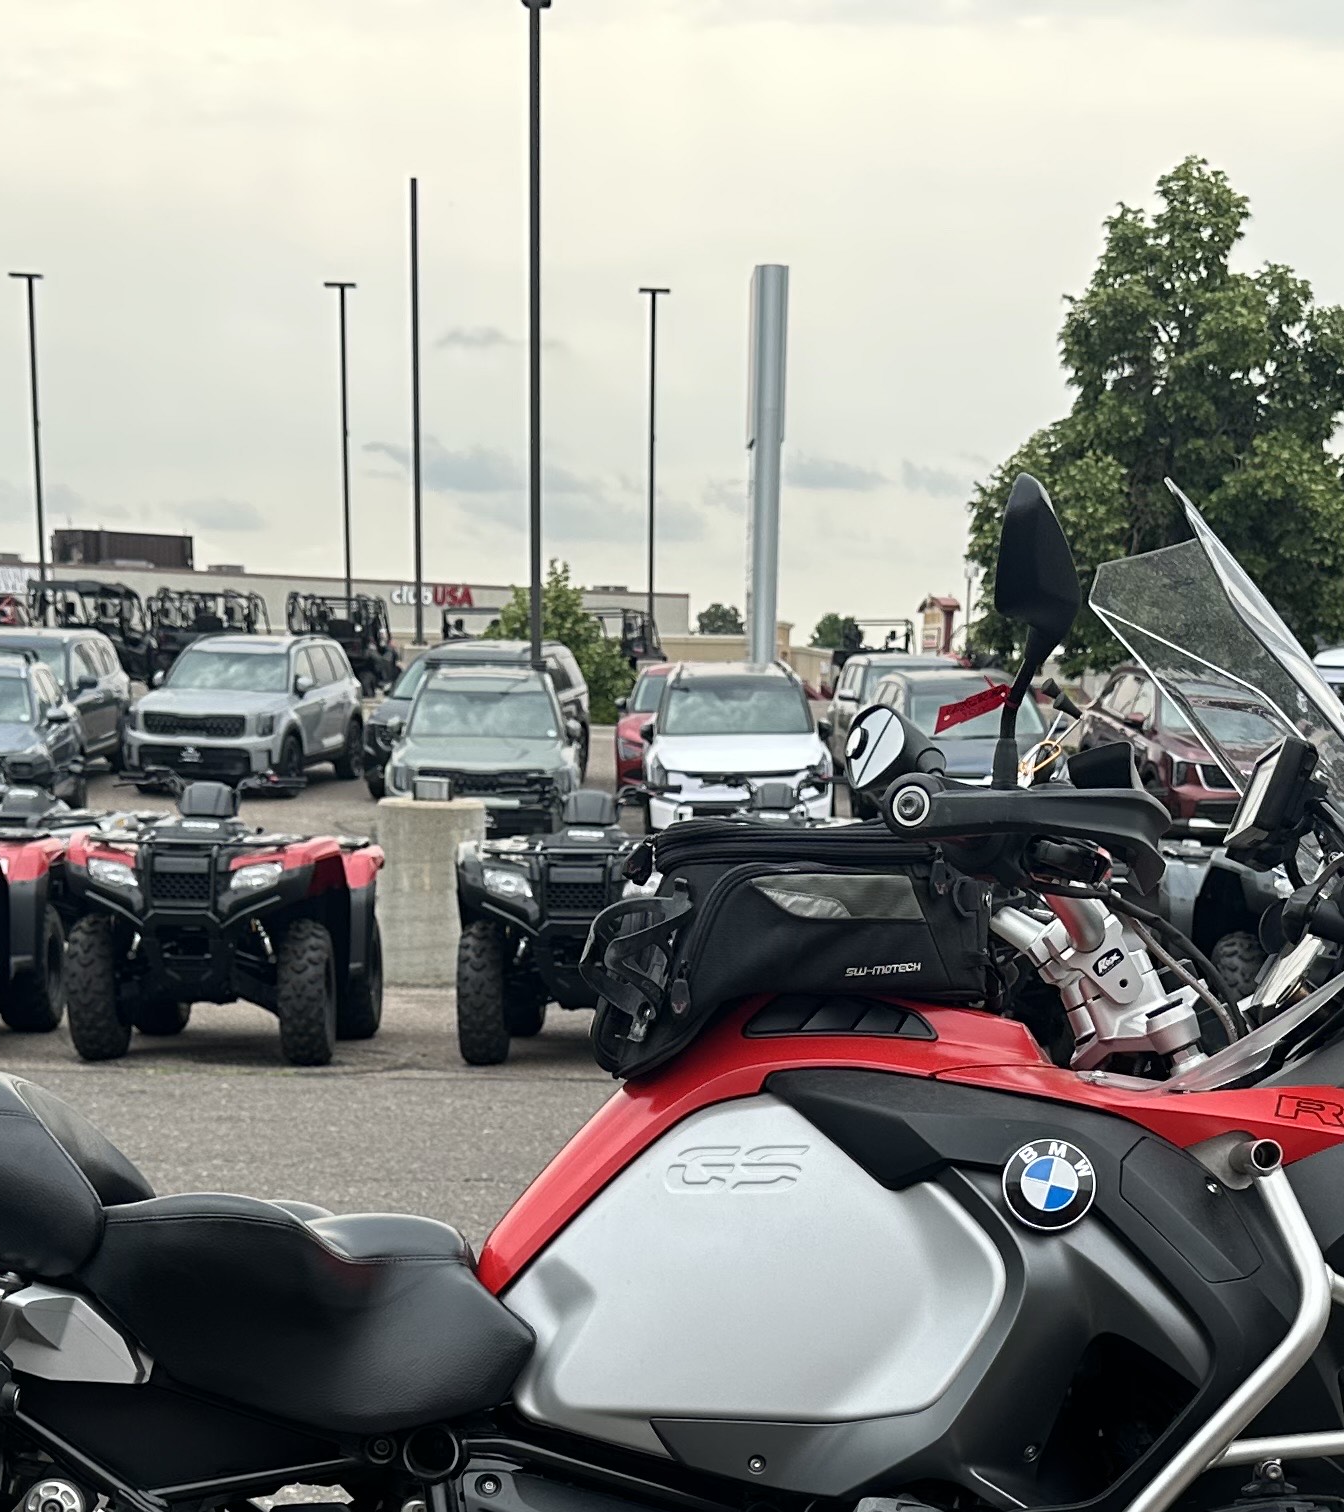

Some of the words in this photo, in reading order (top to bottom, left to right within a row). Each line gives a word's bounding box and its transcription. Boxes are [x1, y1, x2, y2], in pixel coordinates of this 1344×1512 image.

[844, 962, 922, 978] SW-MOTECH
[664, 1144, 811, 1195] GS
[1018, 1141, 1093, 1178] BMW
